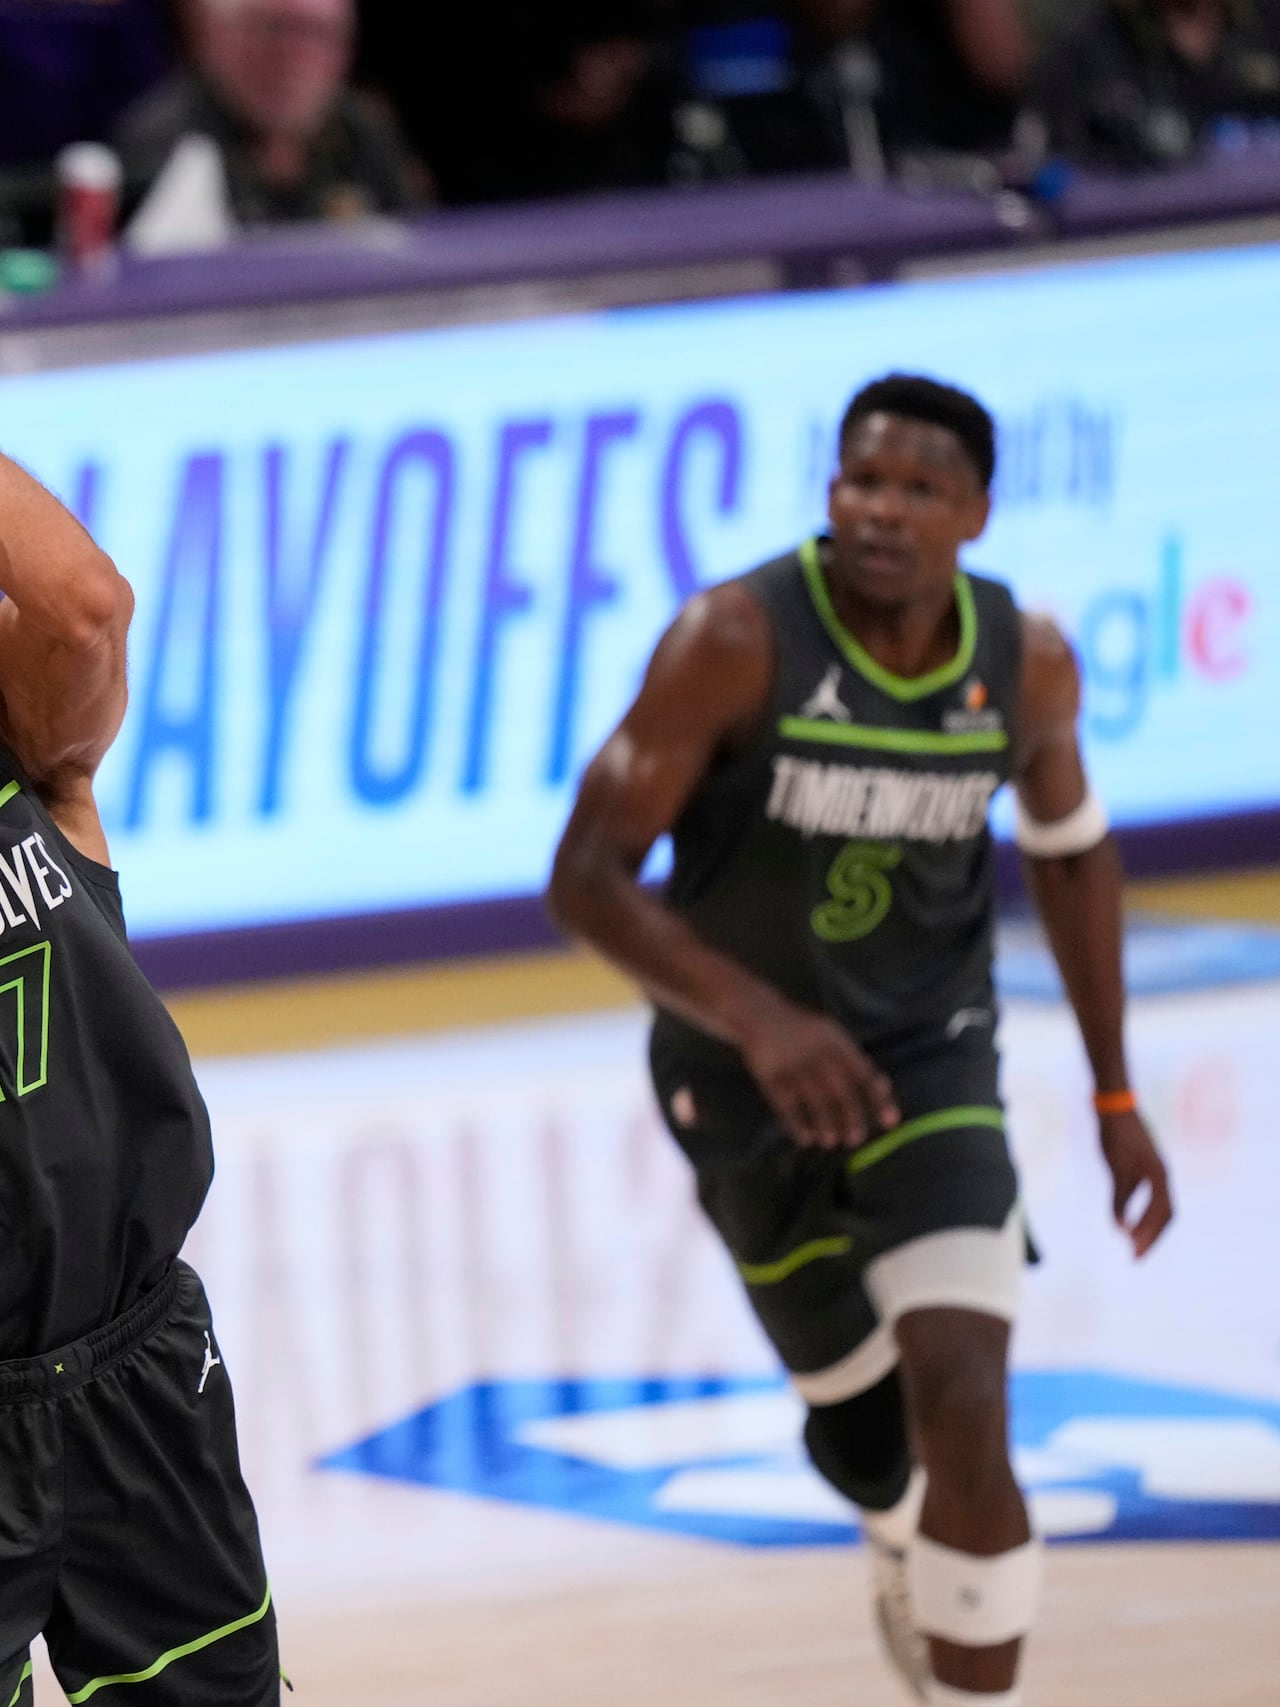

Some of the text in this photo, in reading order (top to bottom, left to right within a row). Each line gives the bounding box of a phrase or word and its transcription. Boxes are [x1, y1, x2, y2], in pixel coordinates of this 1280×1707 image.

[75, 395, 745, 828] AYOFFS
[1080, 538, 1253, 742] gle
[811, 840, 901, 943] 5
